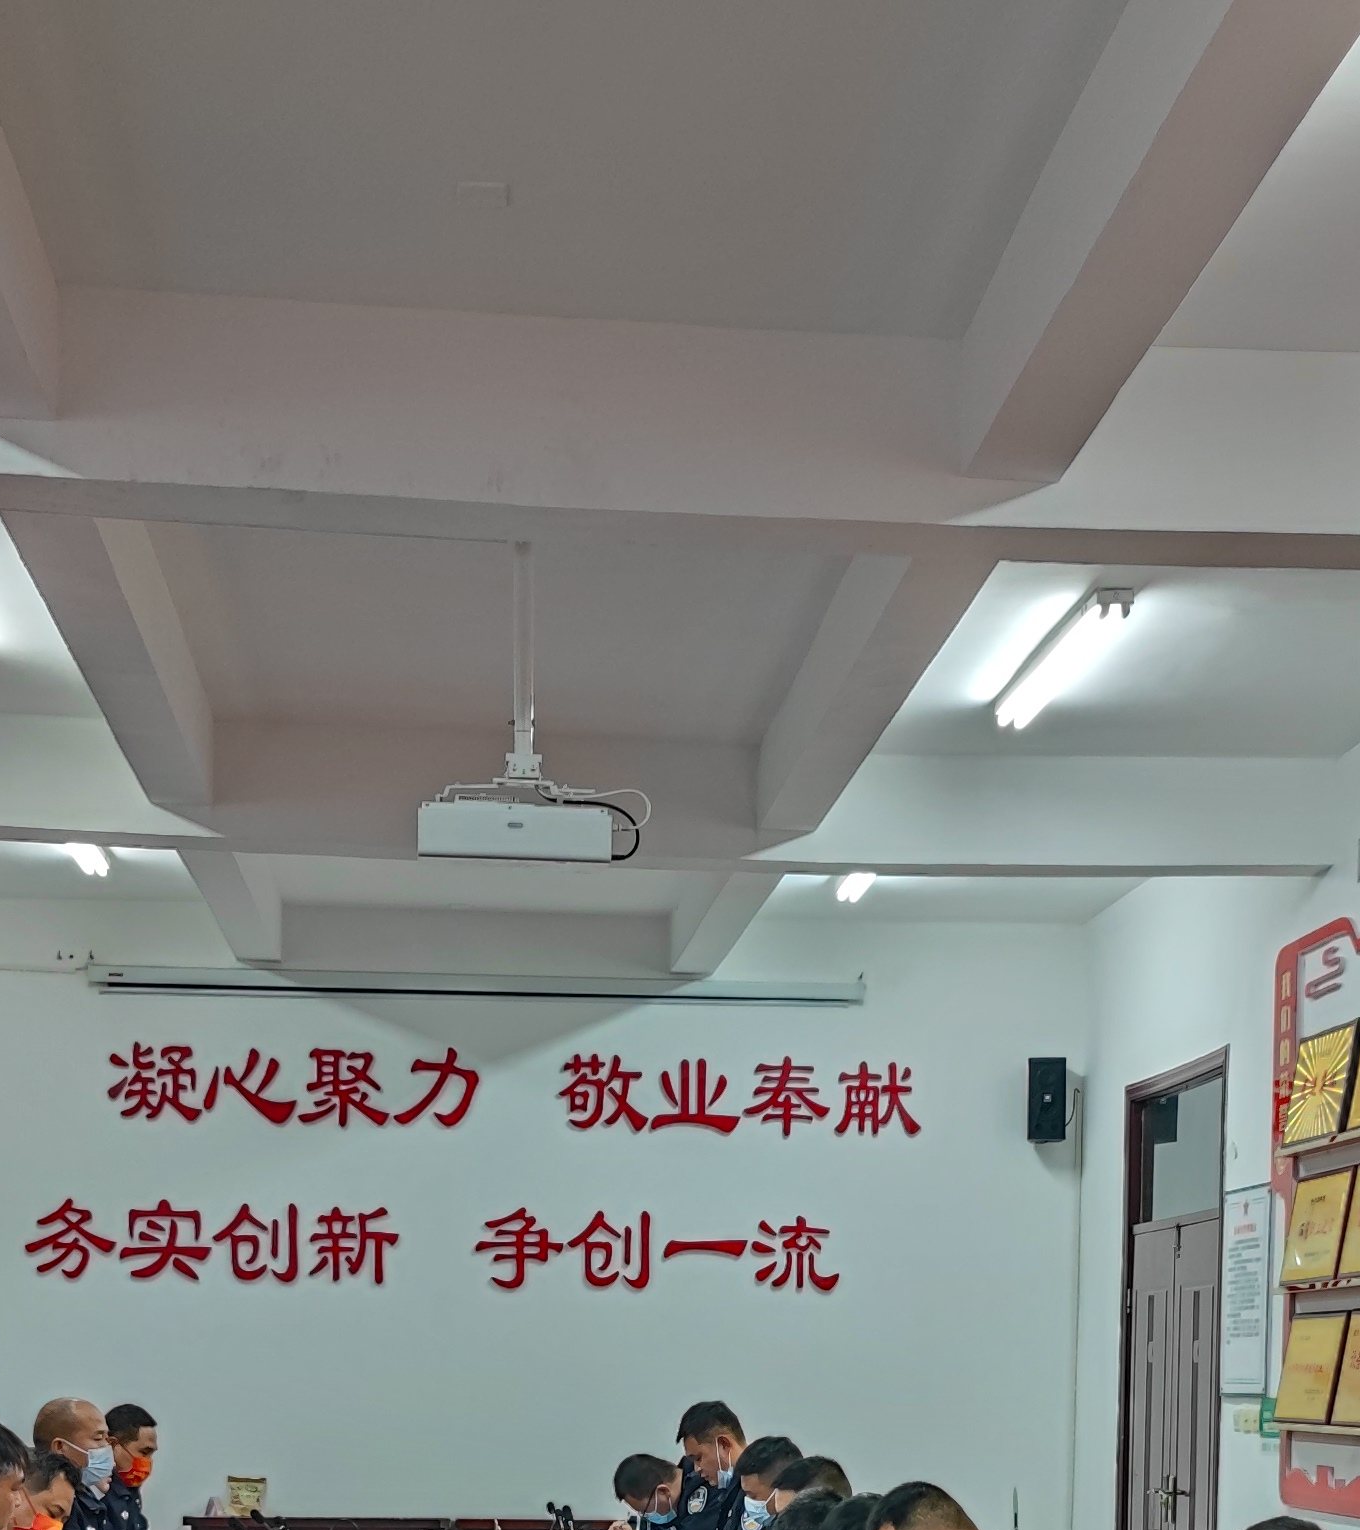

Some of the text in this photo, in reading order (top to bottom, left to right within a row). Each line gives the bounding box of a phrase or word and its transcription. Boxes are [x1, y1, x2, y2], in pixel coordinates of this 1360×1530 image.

[106, 1041, 921, 1138] 凝心聚力 敬业奉献
[25, 1198, 840, 1292] 务实创新 争创一流
